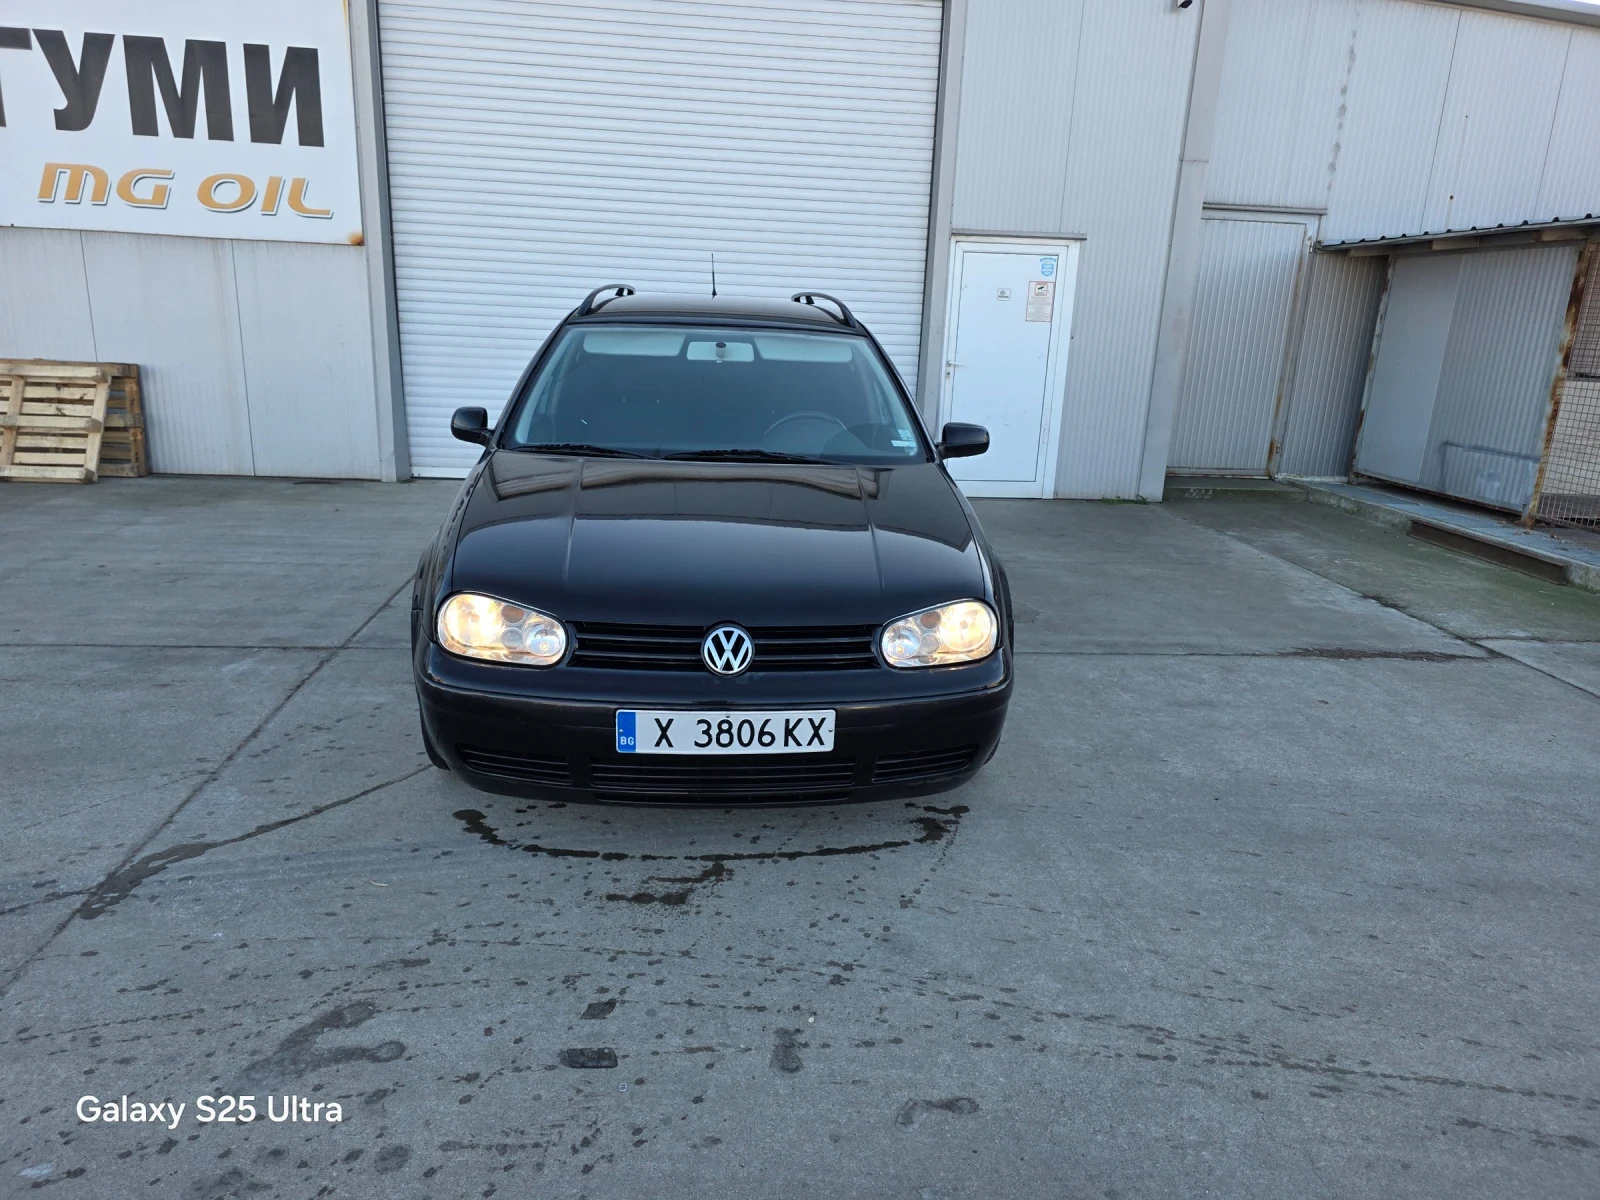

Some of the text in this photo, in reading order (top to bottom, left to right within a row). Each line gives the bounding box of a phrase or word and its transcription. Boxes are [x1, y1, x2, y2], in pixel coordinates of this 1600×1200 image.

[37, 162, 333, 219] MG OIL
[620, 736, 635, 746] BG
[693, 718, 776, 748] 3806
